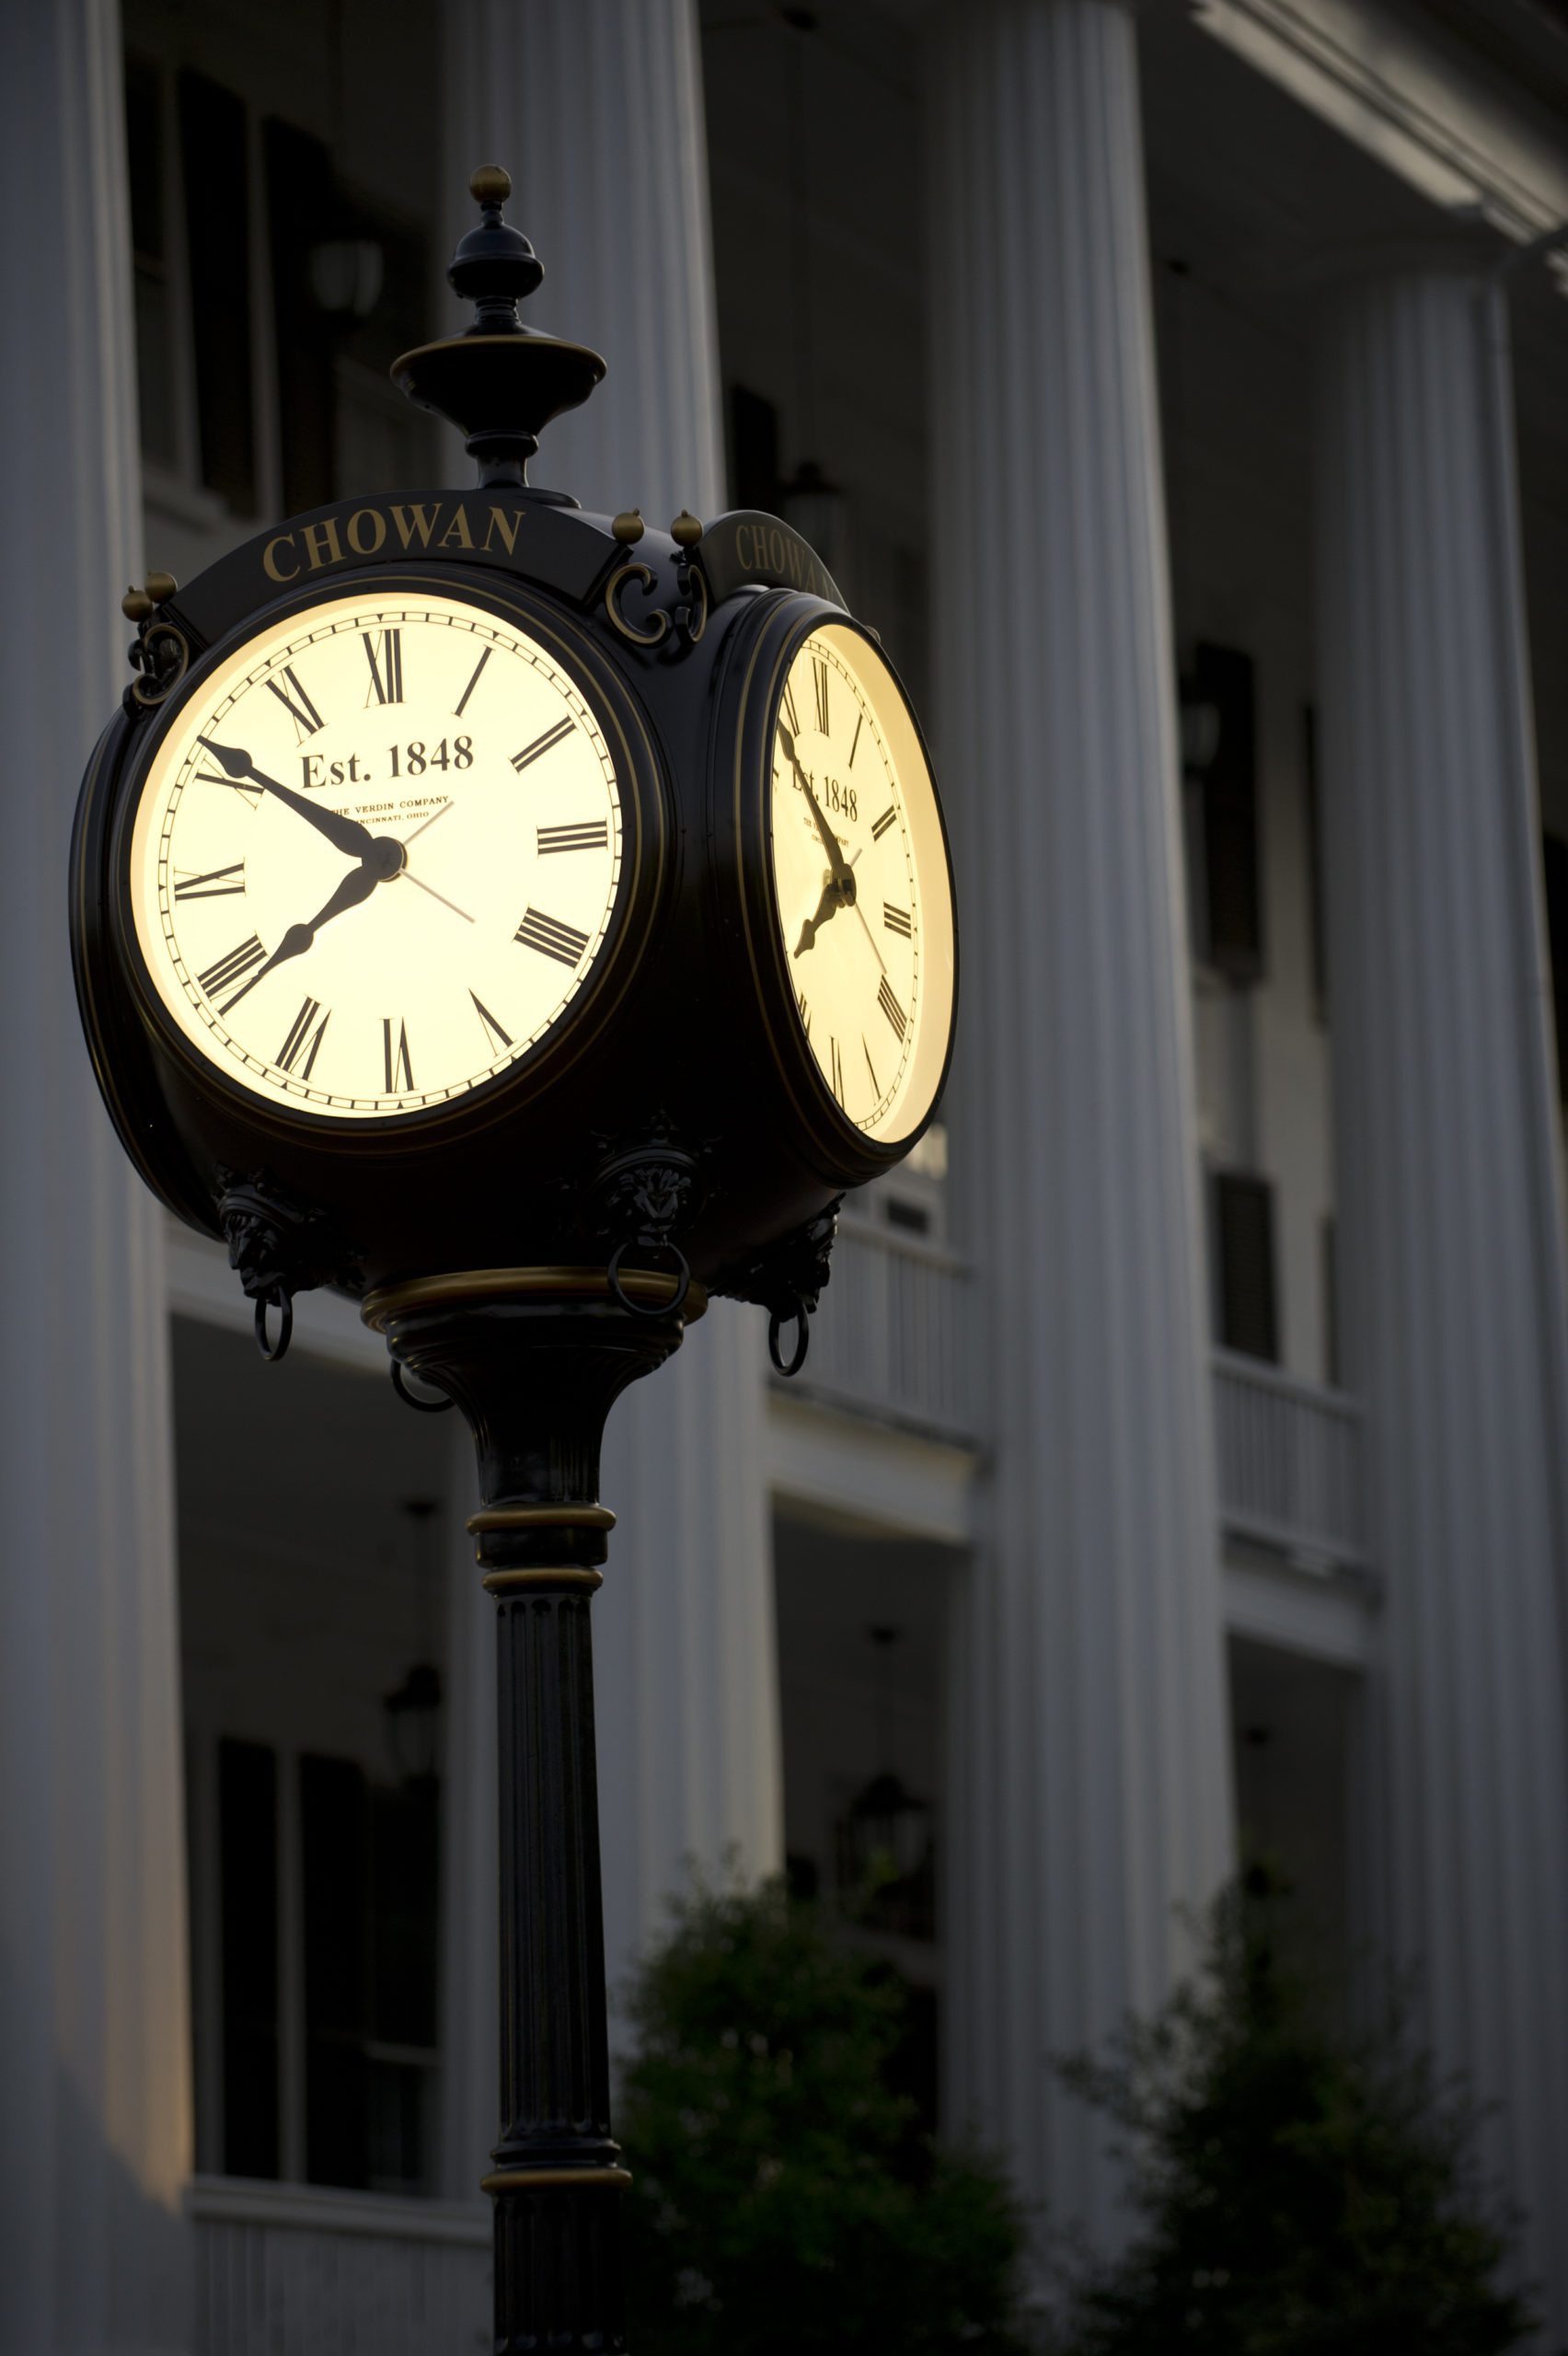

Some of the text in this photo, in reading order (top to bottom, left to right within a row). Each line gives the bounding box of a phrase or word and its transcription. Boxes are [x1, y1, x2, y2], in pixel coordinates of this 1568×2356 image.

[263, 502, 525, 582] CHOWAN
[360, 629, 407, 710] XII
[451, 643, 496, 720] I
[811, 656, 830, 738] XII
[260, 663, 329, 747] XI
[299, 735, 473, 789] Est. 1848
[508, 713, 579, 776] II
[355, 802, 394, 814] VERDIN
[399, 795, 449, 809] COMPANY
[407, 811, 429, 820] OHIO
[824, 776, 858, 822] 1848
[536, 816, 608, 860] III
[173, 856, 246, 907] IX
[511, 902, 592, 973] IIII
[883, 899, 912, 940] III
[271, 993, 331, 1083] VII
[379, 1016, 420, 1094] VI
[467, 987, 517, 1057] V
